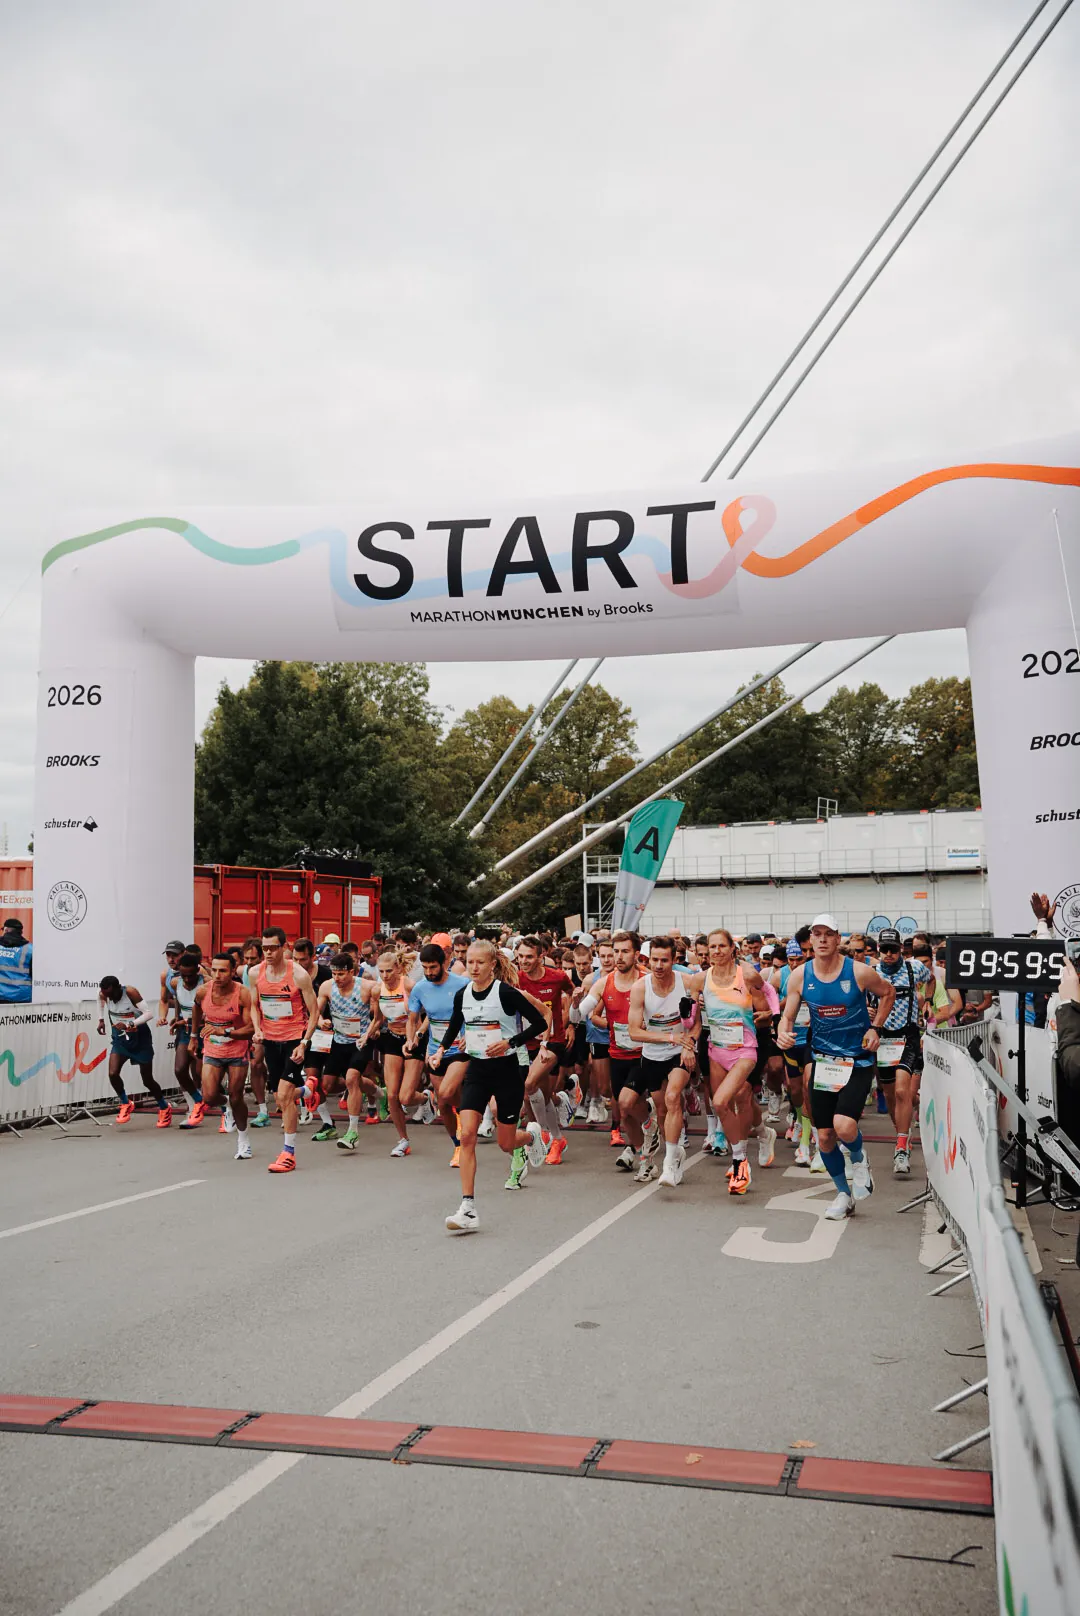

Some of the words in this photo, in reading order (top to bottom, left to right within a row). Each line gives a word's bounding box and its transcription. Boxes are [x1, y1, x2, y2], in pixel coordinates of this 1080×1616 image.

[353, 500, 717, 601] START
[587, 607, 600, 618] by
[603, 601, 654, 616] Brooks
[47, 684, 102, 708] 2026
[46, 754, 101, 768] BROOKS
[44, 818, 82, 829] schuster
[633, 826, 660, 862] A
[49, 883, 84, 901] PAULANER
[64, 980, 79, 988] Run
[71, 1012, 91, 1022] Brooks
